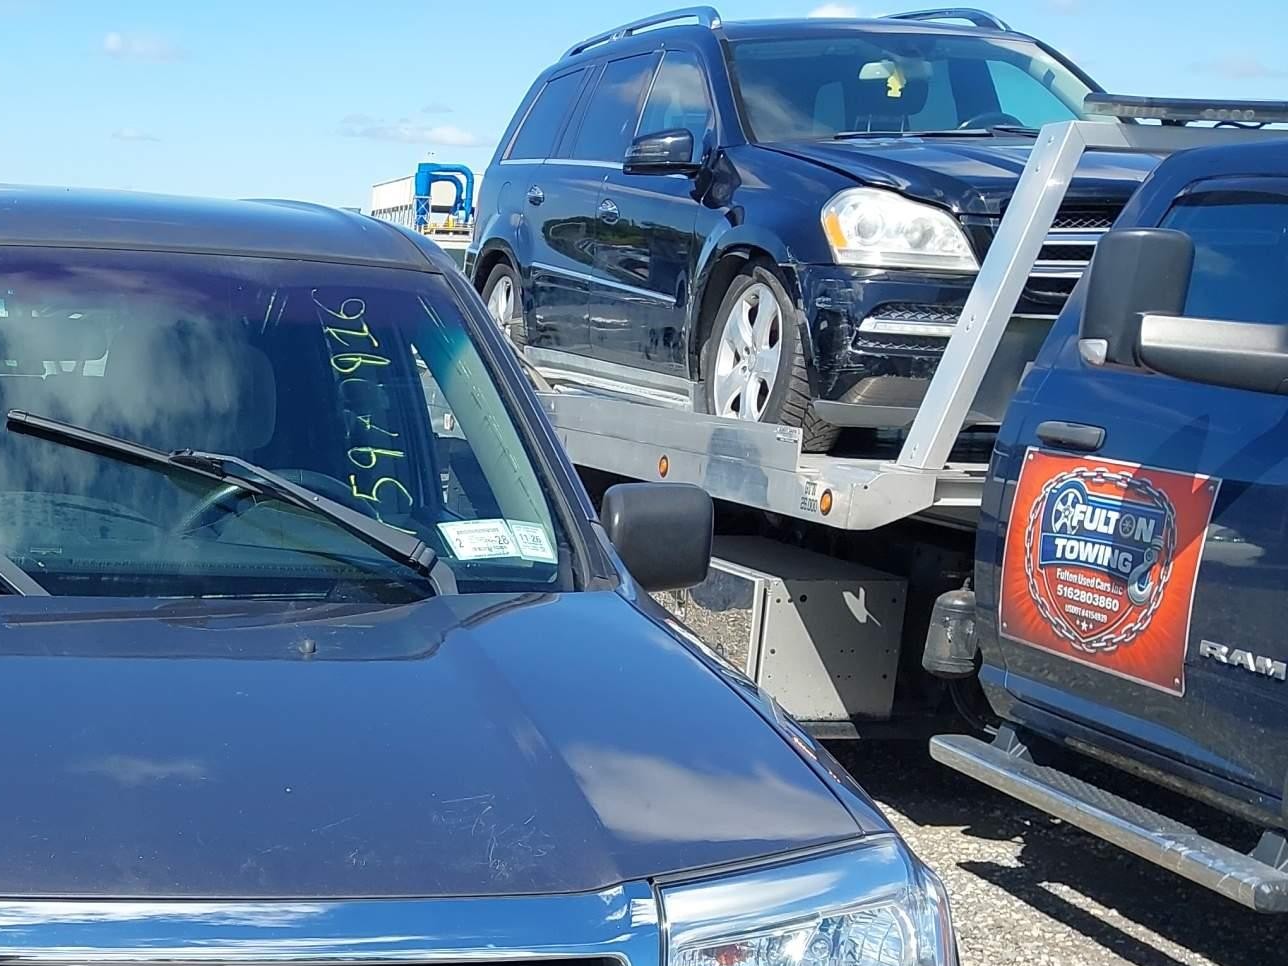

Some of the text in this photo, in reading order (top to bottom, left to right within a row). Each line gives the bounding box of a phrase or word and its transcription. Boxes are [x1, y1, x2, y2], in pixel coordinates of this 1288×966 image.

[1073, 503, 1156, 543] FULTON
[1054, 538, 1133, 574] TOWING
[1056, 568, 1078, 583] Fulton
[1078, 573, 1095, 588] Used
[1095, 578, 1111, 592] Cars
[1056, 585, 1120, 612] 5162803860
[1199, 639, 1287, 681] RAM
